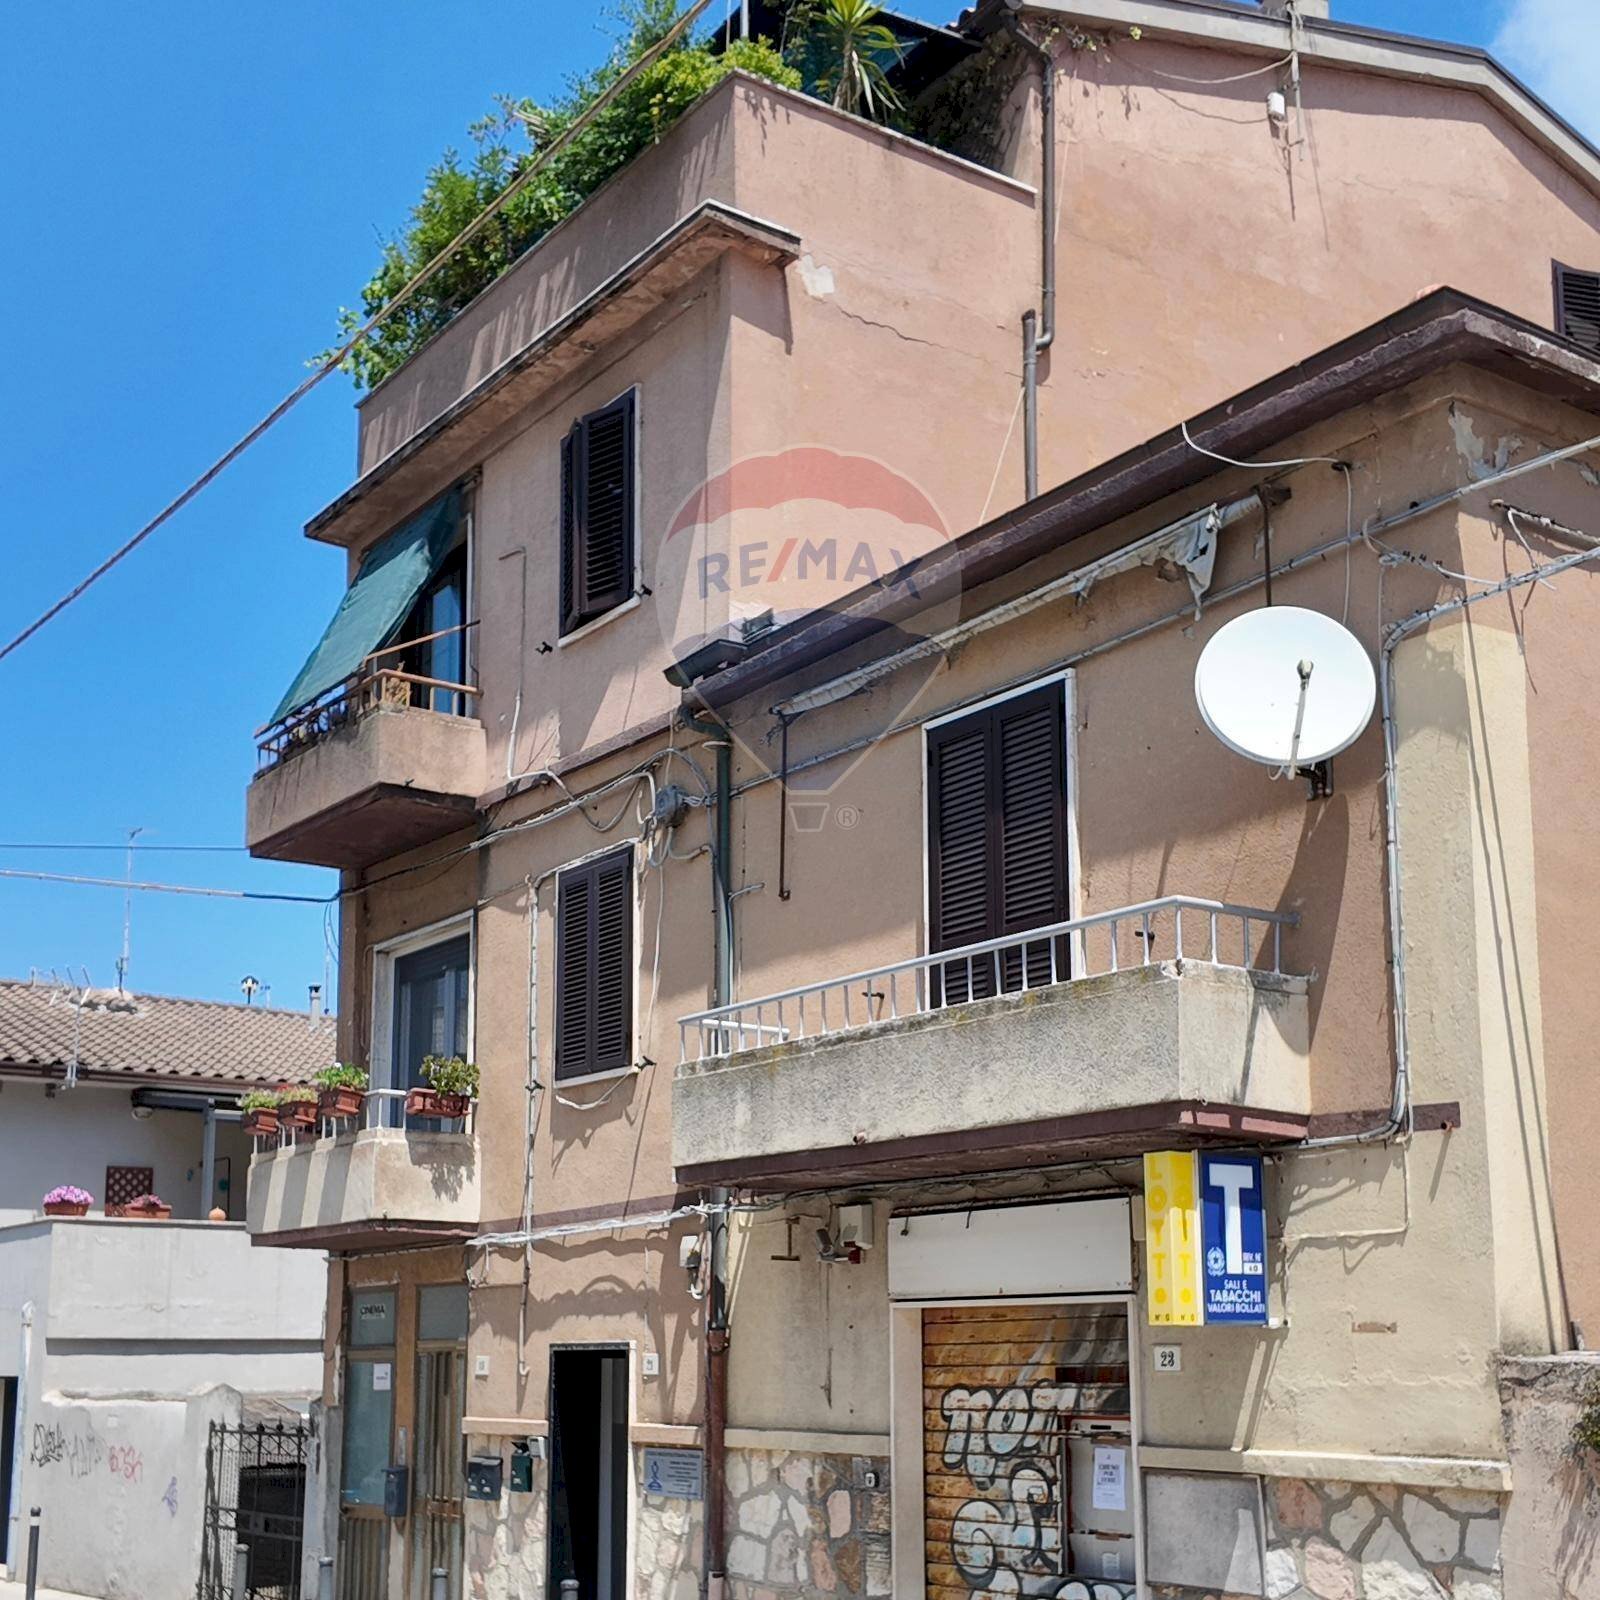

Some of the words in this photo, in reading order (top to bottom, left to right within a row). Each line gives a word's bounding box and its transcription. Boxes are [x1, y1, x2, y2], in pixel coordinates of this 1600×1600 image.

[1209, 1163, 1254, 1275] T
[1148, 1155, 1167, 1304] LOTTO
[1224, 1279, 1240, 1290] SALI
[1242, 1279, 1248, 1290] E
[1210, 1289, 1261, 1303] TABACCHI
[1207, 1302, 1235, 1314] VALORI
[1236, 1303, 1265, 1314] BOLLATI
